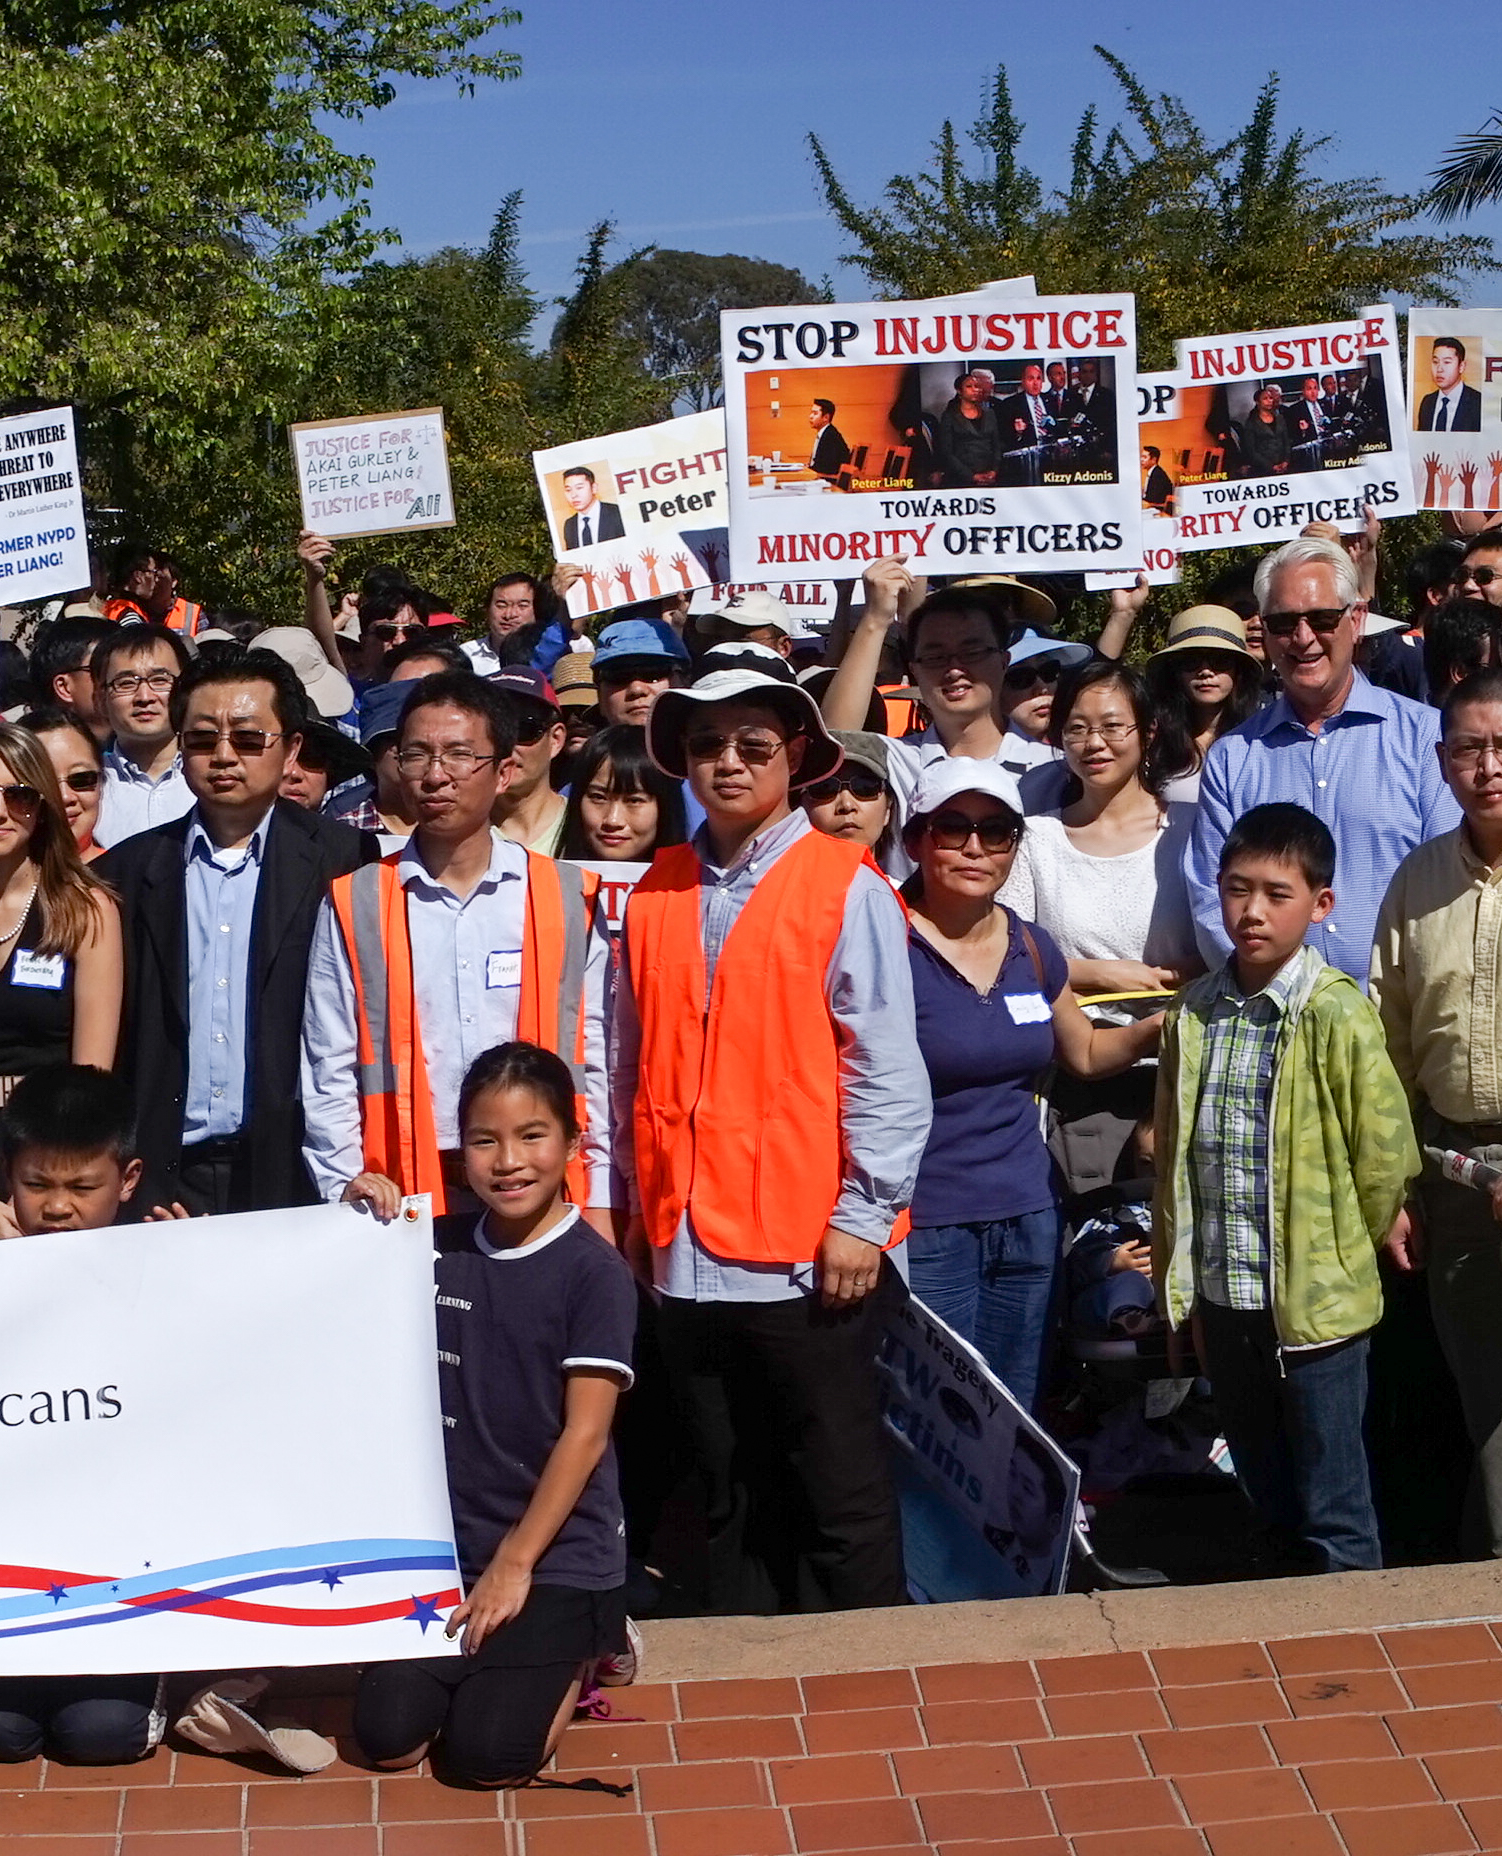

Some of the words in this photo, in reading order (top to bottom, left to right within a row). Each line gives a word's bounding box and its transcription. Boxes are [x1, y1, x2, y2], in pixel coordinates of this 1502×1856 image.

[737, 321, 859, 363] STOP
[874, 309, 1127, 356] INJUSTICE
[4, 424, 67, 451] ANYWHERE
[305, 434, 370, 457] JUSTICE
[379, 429, 413, 448] FOR
[38, 451, 54, 469] TO
[307, 458, 342, 476] AKAI
[348, 449, 402, 468] GURLEY
[408, 446, 419, 460] &
[308, 474, 361, 494] PETER
[852, 477, 882, 490] Peter
[884, 475, 914, 489] Liang
[1043, 471, 1072, 484] Kizzy
[1074, 469, 1113, 482] Adonis
[1179, 473, 1203, 484] Peter
[311, 493, 379, 518] JUSTICE
[384, 488, 415, 507] FOR
[1203, 482, 1290, 504] TOWARDS
[640, 490, 717, 524] Peter
[881, 496, 995, 519] TOWARDS
[36, 527, 75, 546] NYPD
[758, 522, 937, 564] MINORITY
[943, 522, 1123, 555] OFFICERS
[17, 552, 63, 574] LIANG!
[779, 584, 827, 606] ALL
